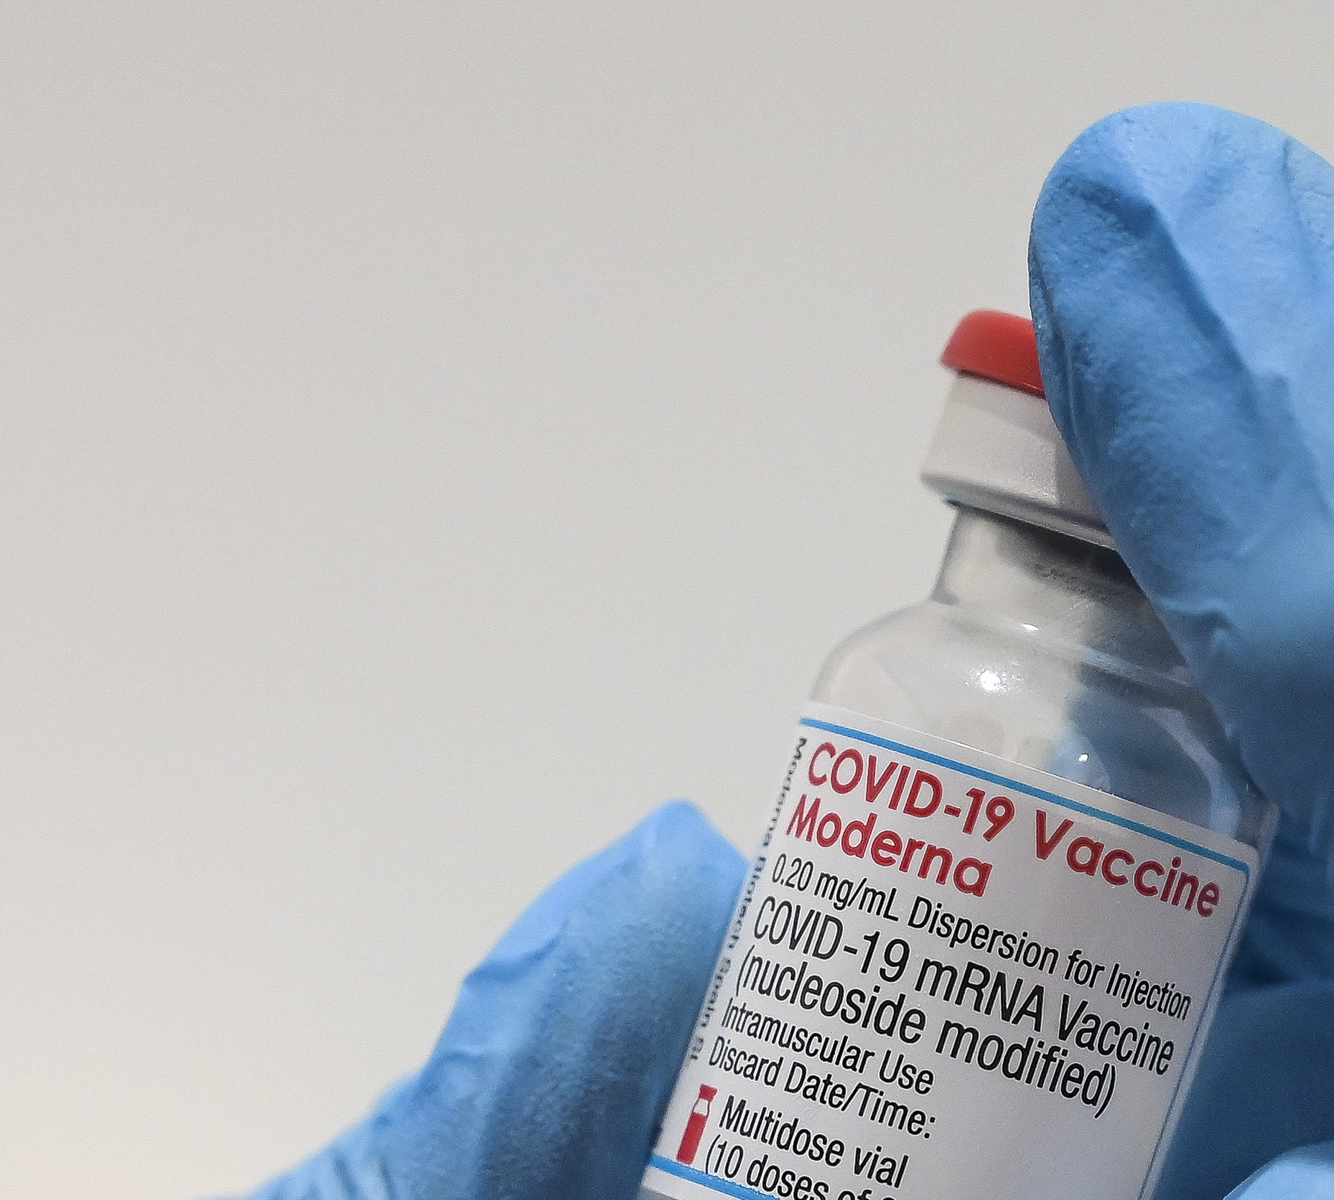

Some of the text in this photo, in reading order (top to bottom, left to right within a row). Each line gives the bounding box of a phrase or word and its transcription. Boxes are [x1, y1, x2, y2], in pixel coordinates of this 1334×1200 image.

[787, 795, 992, 897] Moderna
[810, 743, 1220, 918] COVID-19 Vaccine
[754, 896, 1174, 1076] COVID-19 mRNA Vaccine
[772, 854, 1192, 1021] 0.20 mg/mL Dispersion for Injection
[721, 997, 934, 1094] Intramuscular Use
[736, 945, 1116, 1119] (nucleoside modified)
[709, 1036, 936, 1139] Discard Date/Time:
[705, 1134, 743, 1178] (10
[719, 1095, 909, 1188] Multidose vial
